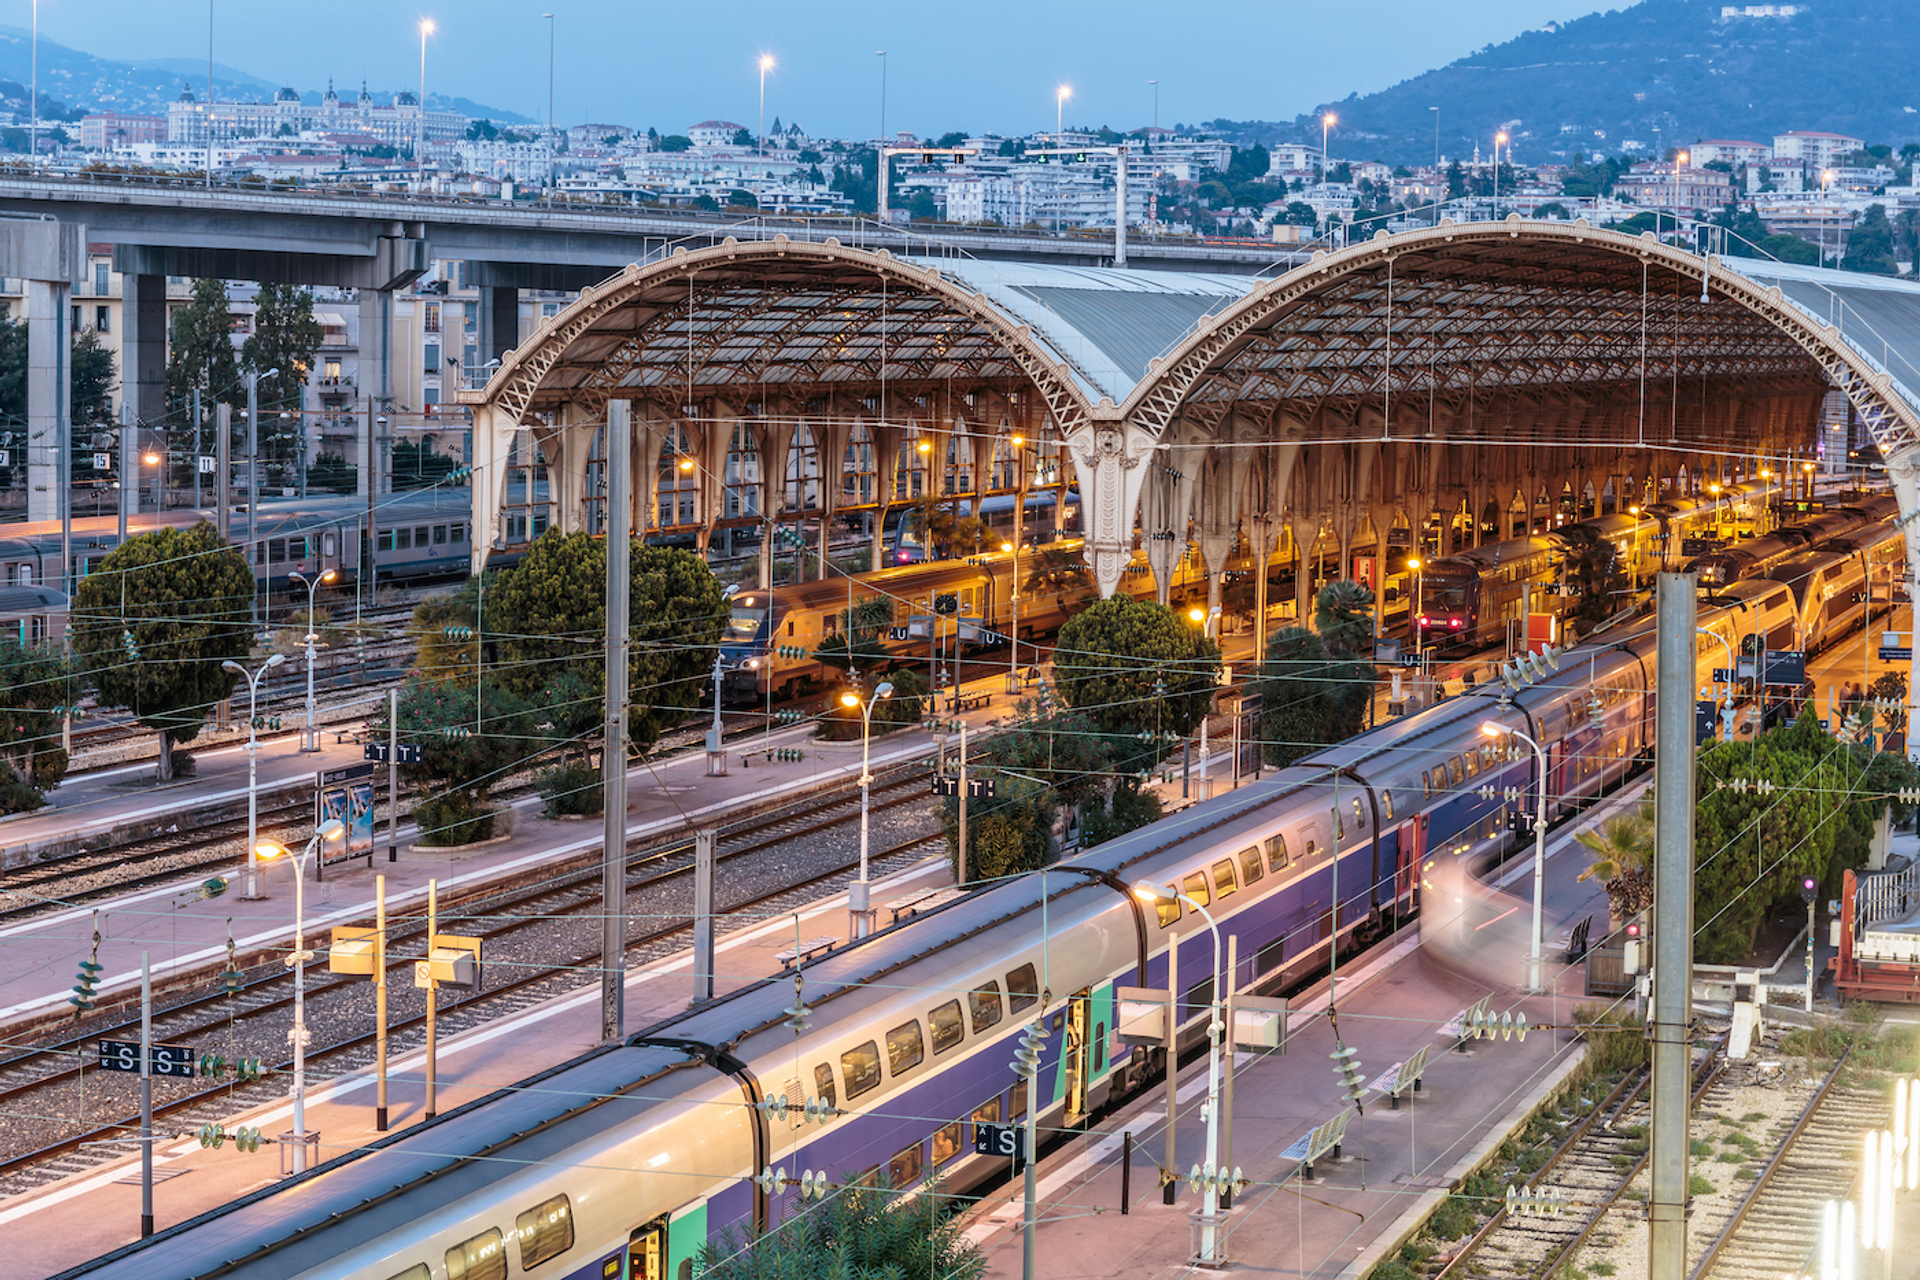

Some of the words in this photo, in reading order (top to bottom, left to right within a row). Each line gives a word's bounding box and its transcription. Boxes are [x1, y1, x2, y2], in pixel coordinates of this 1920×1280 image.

[96, 455, 106, 467] 15
[202, 459, 210, 470] 11
[1567, 586, 1576, 595] V
[1858, 593, 1867, 602] V
[897, 629, 906, 640] U
[986, 634, 995, 644] U
[1404, 655, 1414, 667] U
[376, 746, 386, 760] T
[400, 747, 410, 761] T
[944, 780, 956, 795] T
[970, 781, 982, 797] T
[1522, 814, 1535, 830] T
[118, 1047, 134, 1070] S
[157, 1050, 173, 1074] S
[979, 1127, 986, 1136] A
[998, 1130, 1017, 1154] S
